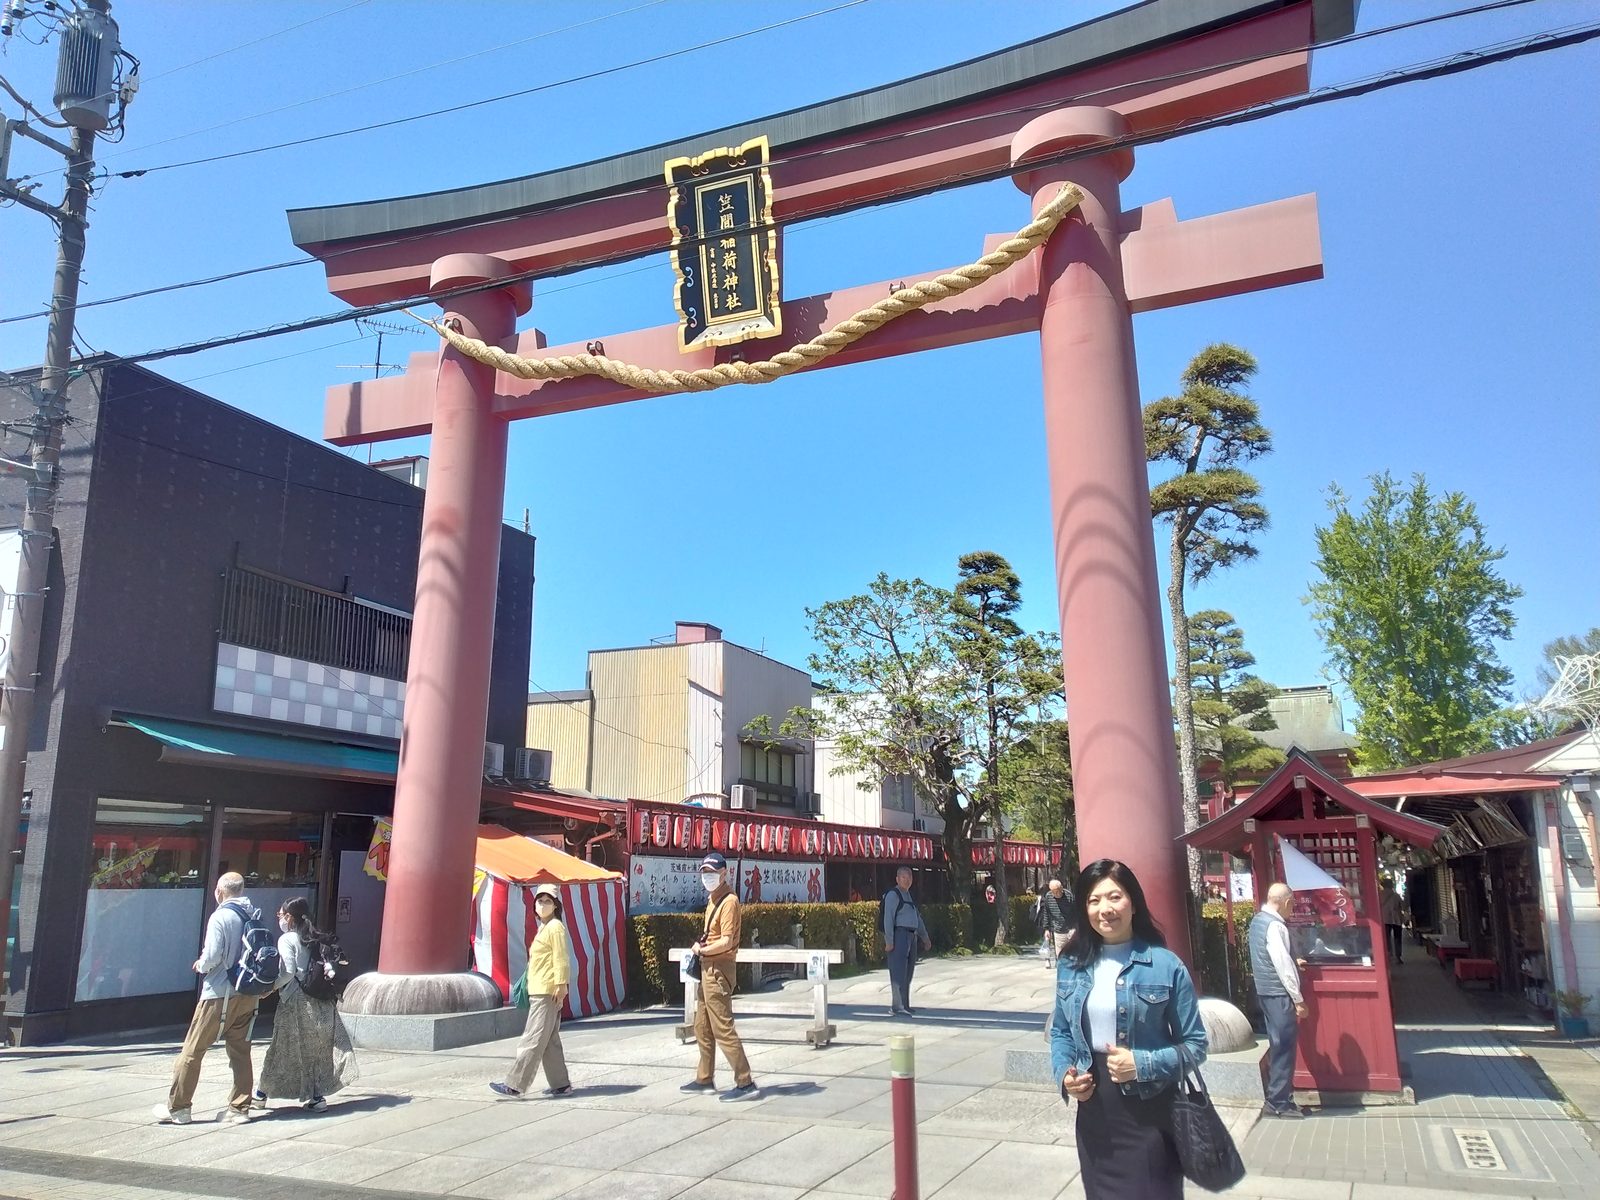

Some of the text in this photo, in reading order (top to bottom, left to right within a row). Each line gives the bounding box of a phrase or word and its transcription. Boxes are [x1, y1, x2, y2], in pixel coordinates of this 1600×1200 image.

[718, 193, 742, 310] 笠間稲荷神社
